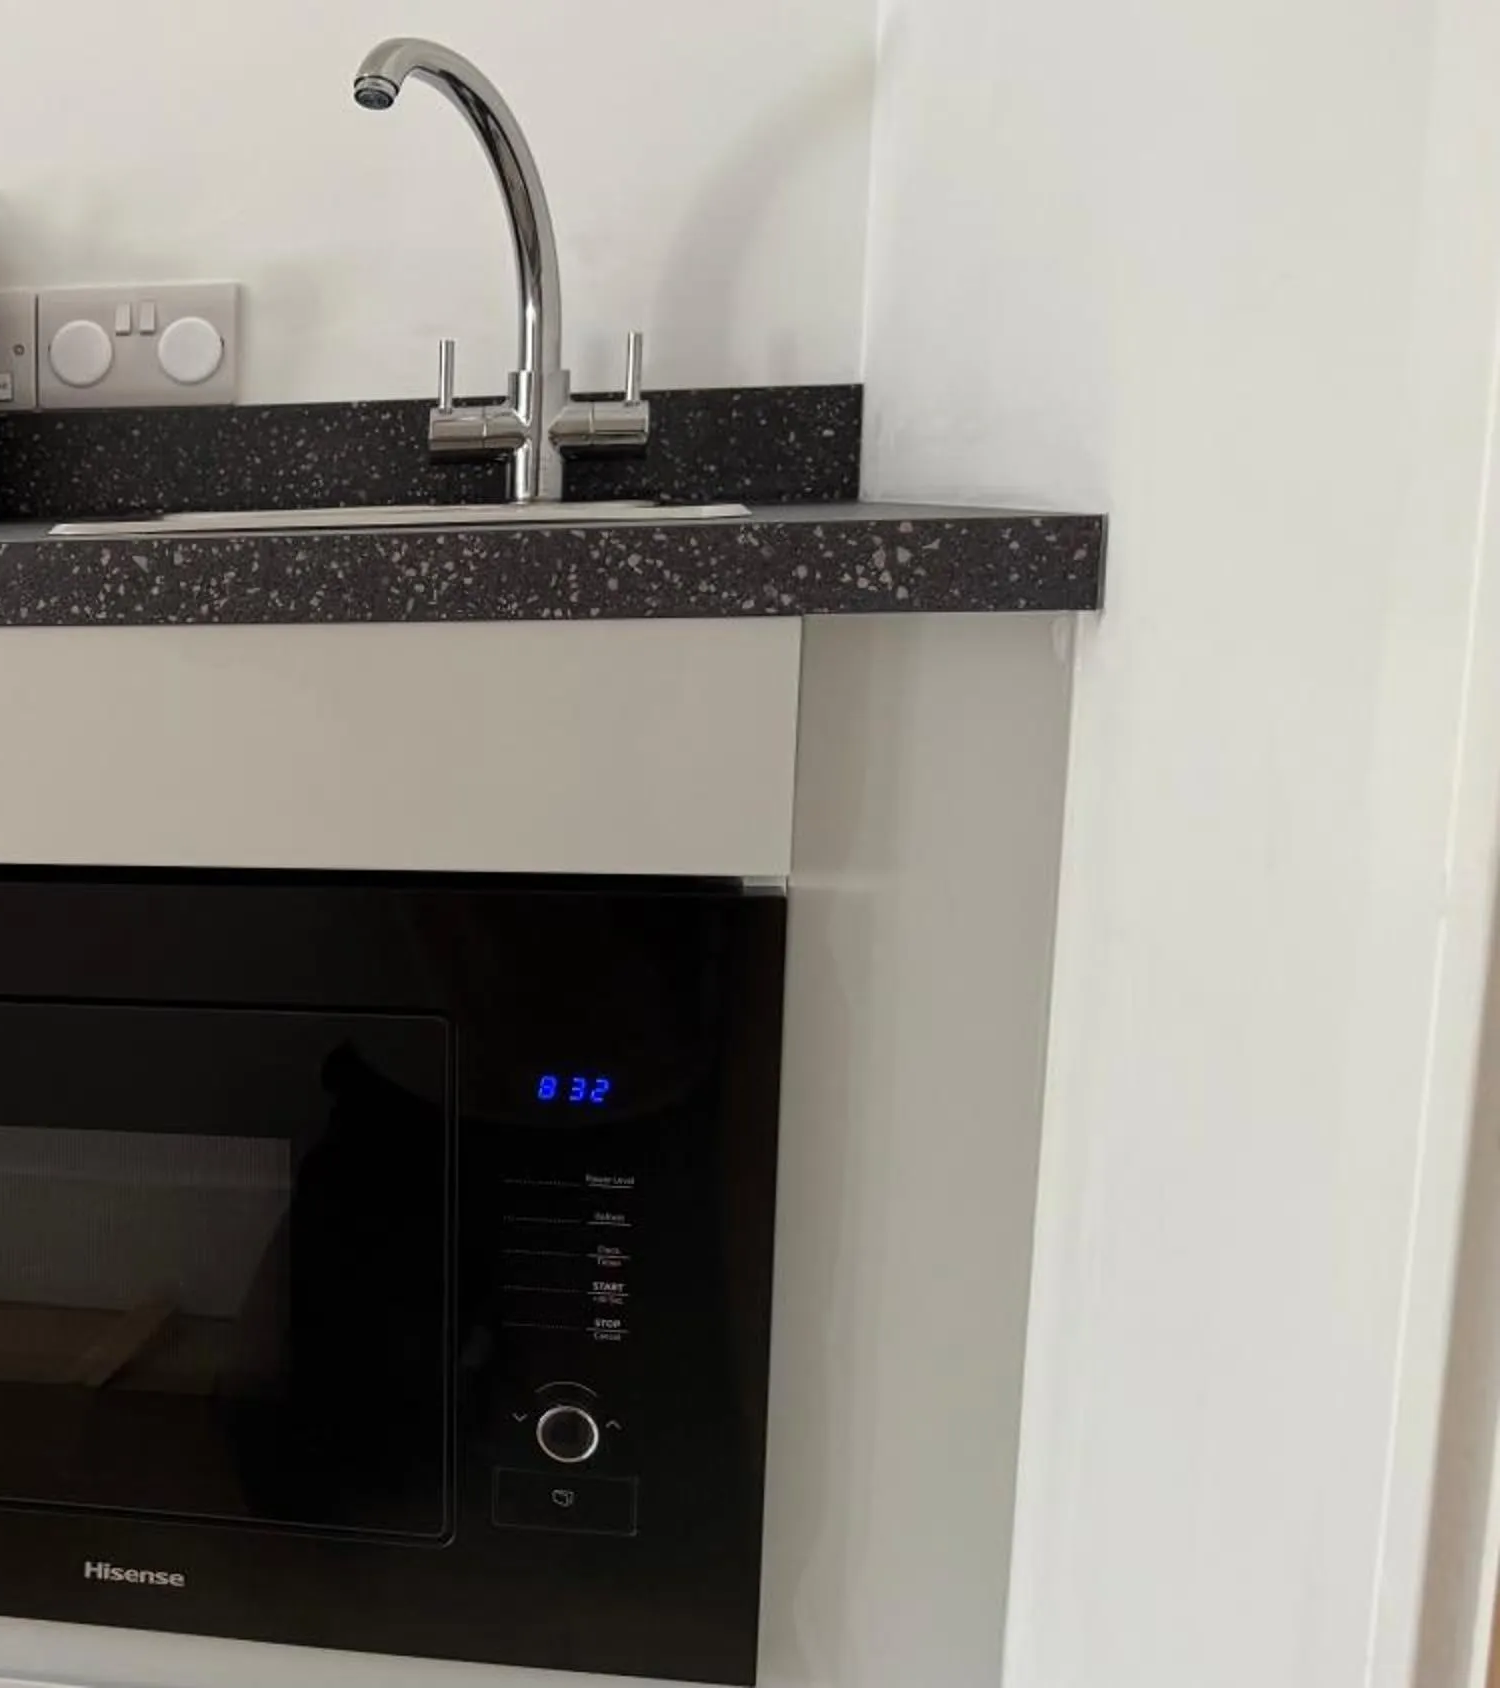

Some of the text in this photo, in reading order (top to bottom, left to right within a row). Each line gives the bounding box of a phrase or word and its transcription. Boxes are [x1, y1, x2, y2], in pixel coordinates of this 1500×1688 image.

[592, 1281, 626, 1292] START
[594, 1318, 621, 1328] STOP
[83, 1560, 186, 1588] Hisense
